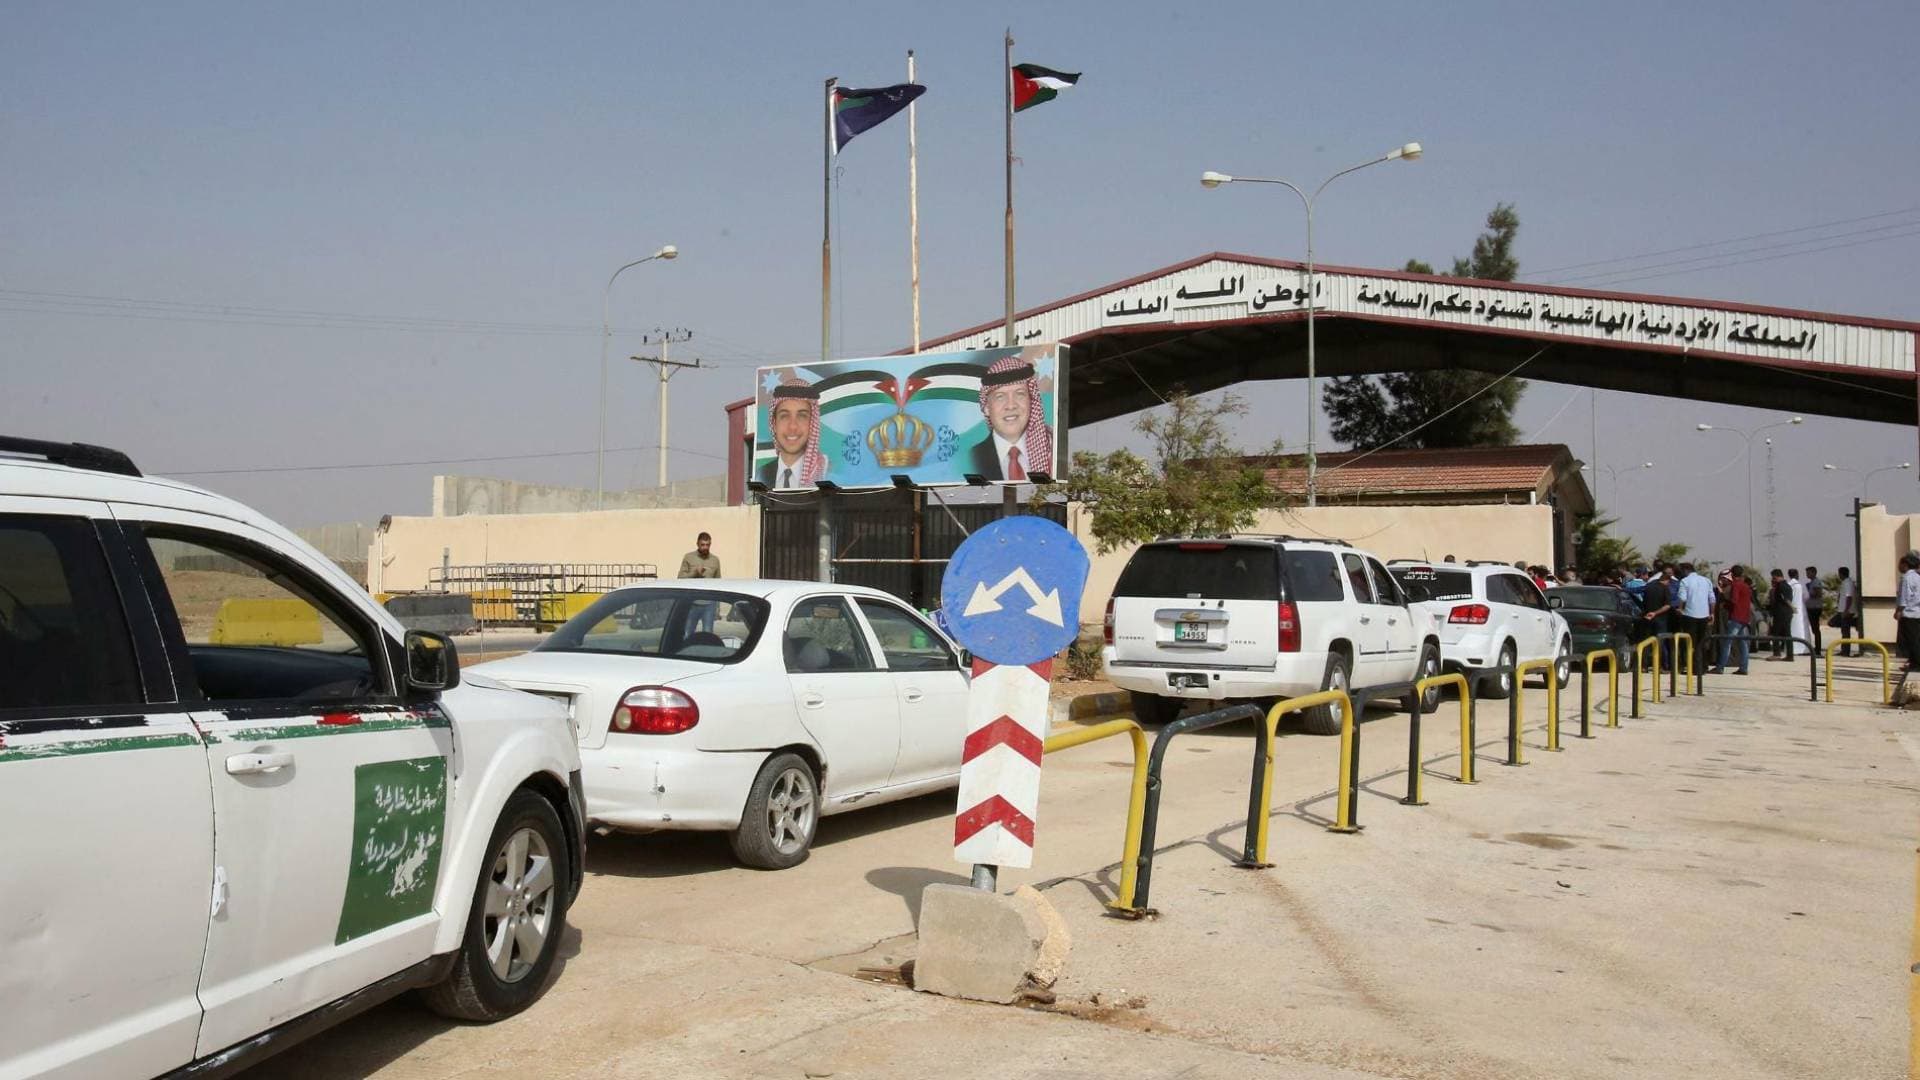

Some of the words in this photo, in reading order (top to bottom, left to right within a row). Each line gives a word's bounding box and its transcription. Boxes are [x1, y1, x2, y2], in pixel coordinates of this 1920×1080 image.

[1176, 275, 1244, 300] الله
[1357, 284, 1428, 310] السلامة
[1106, 296, 1168, 317] الملك
[1431, 293, 1533, 322] تستودعكم
[1540, 302, 1634, 334] الهاشمية
[1727, 320, 1817, 352] المملكة
[1189, 623, 1198, 631] 50
